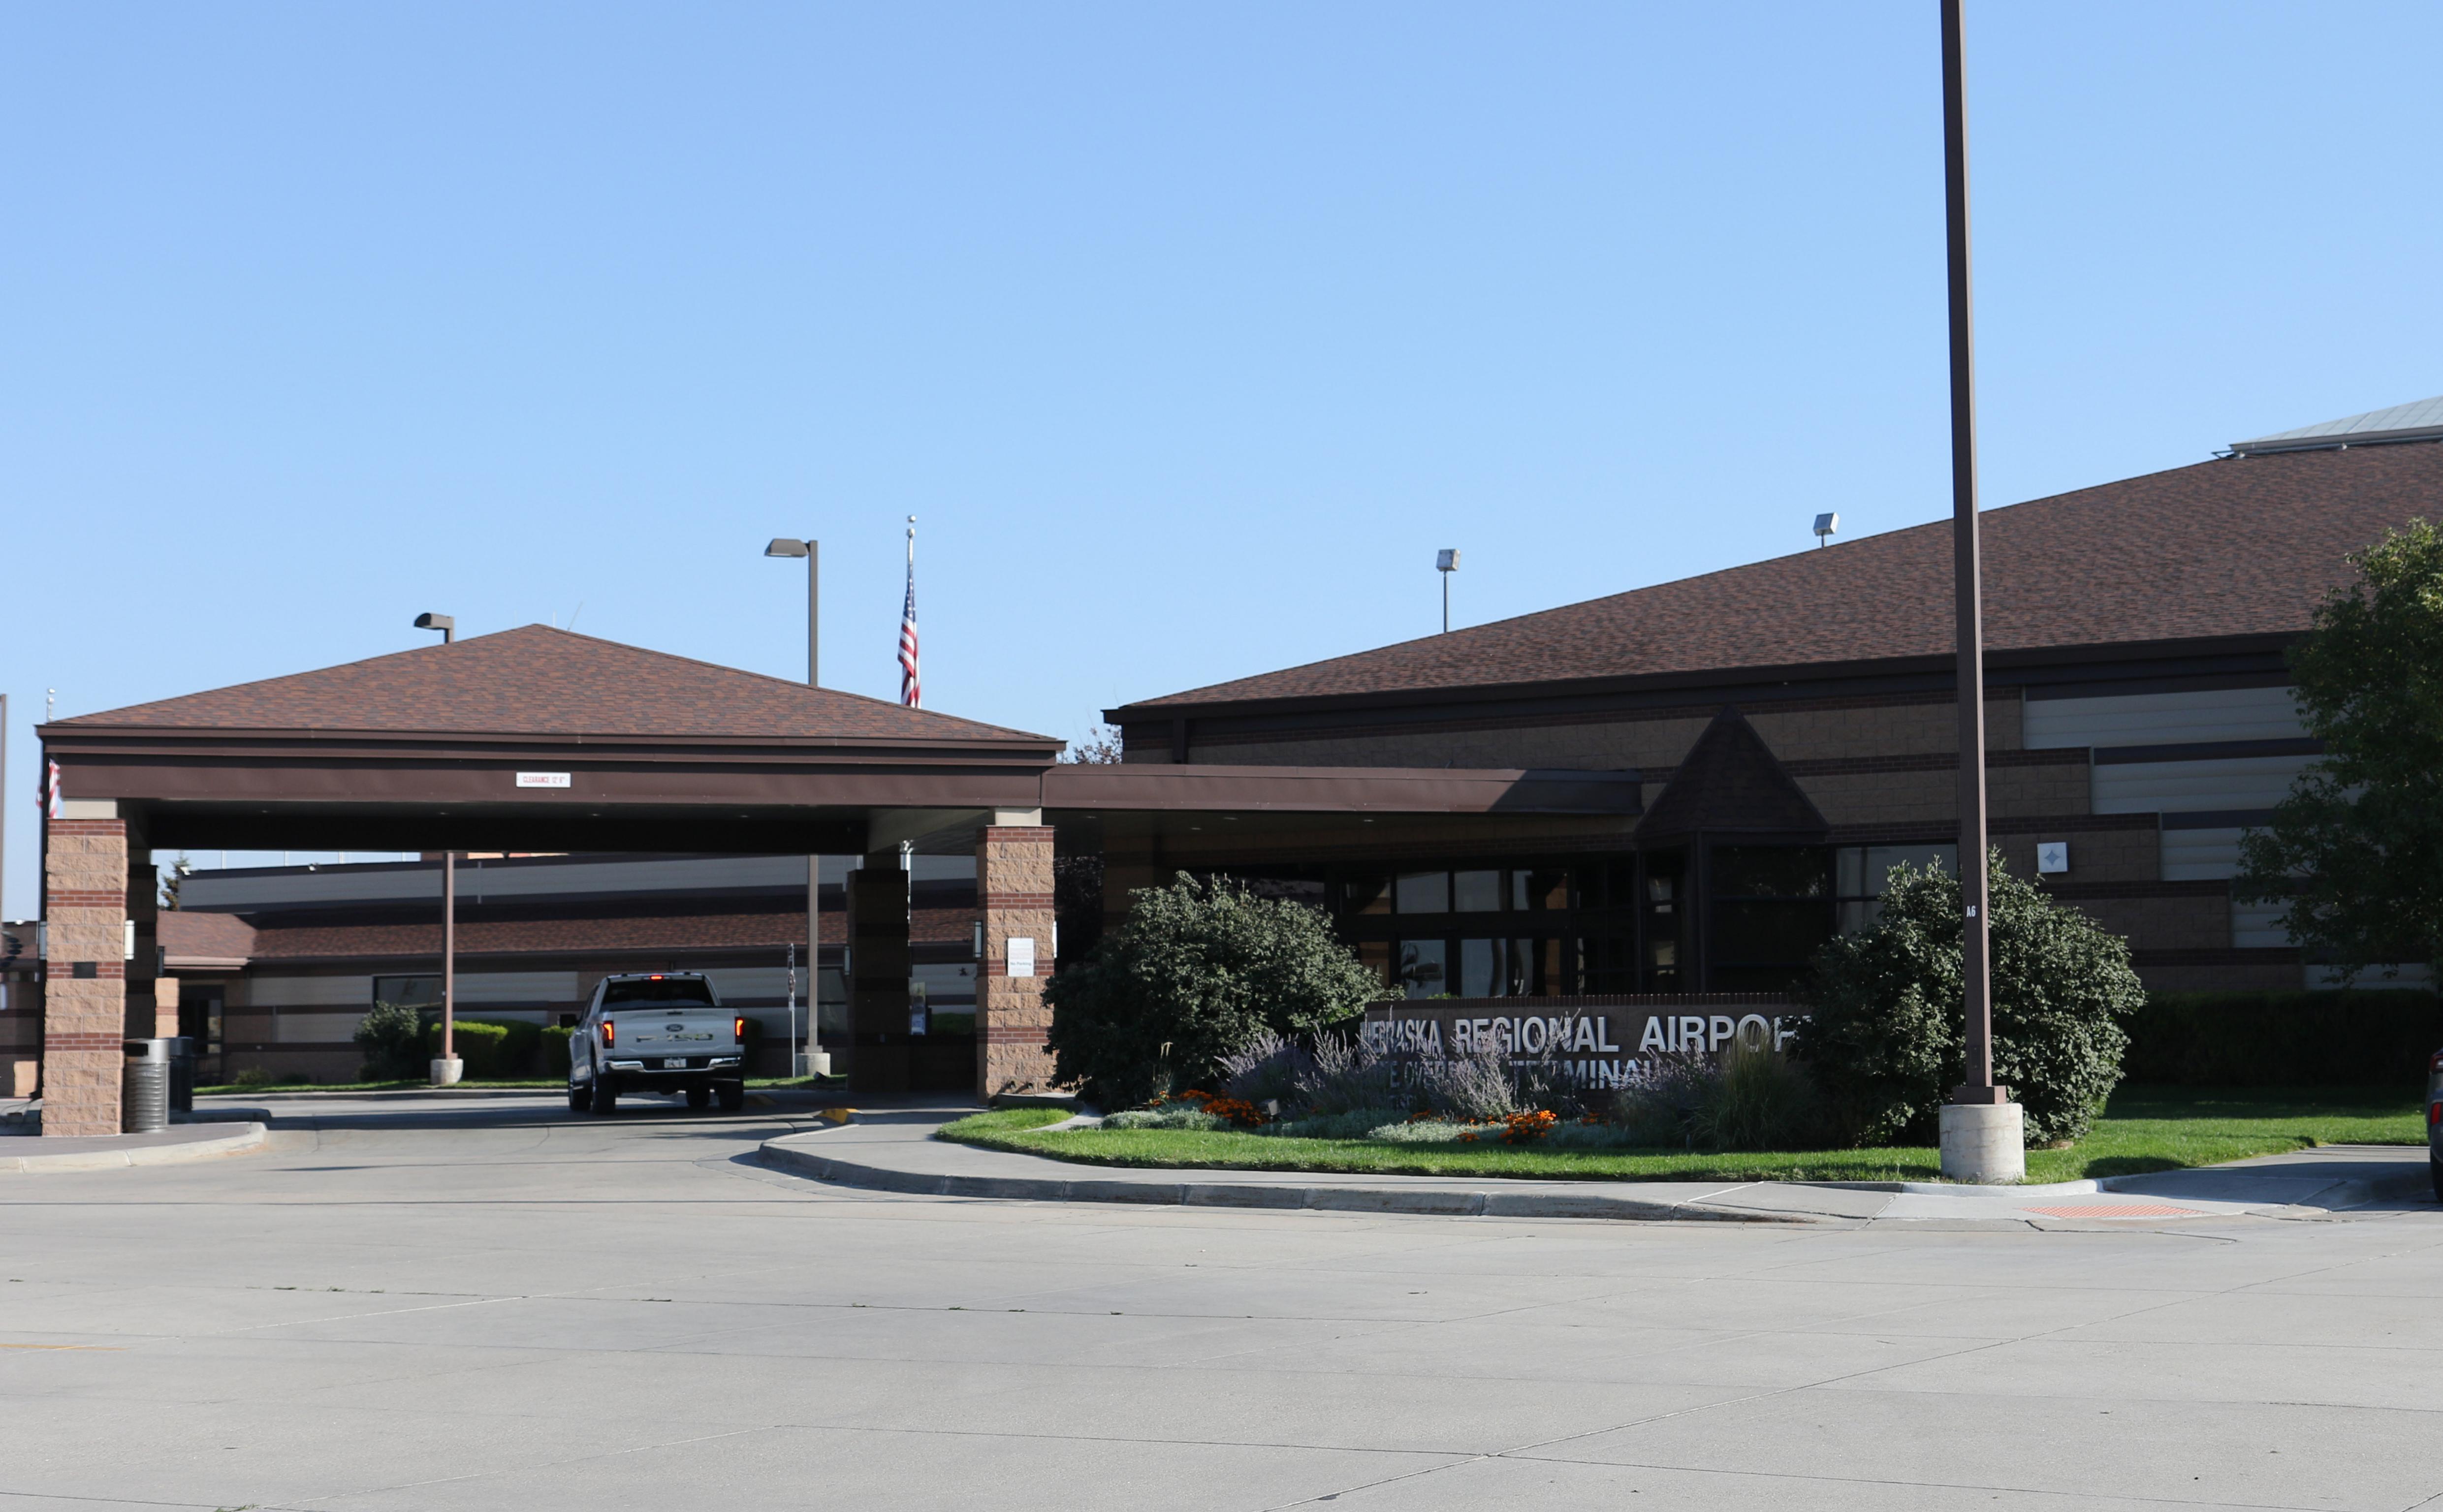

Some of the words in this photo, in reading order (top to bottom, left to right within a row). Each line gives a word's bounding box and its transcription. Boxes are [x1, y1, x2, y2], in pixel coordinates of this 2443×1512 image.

[1966, 906, 1976, 917] A6
[1456, 1016, 1619, 1053] REGIONAL
[1639, 1014, 1811, 1052] AIRPOR
